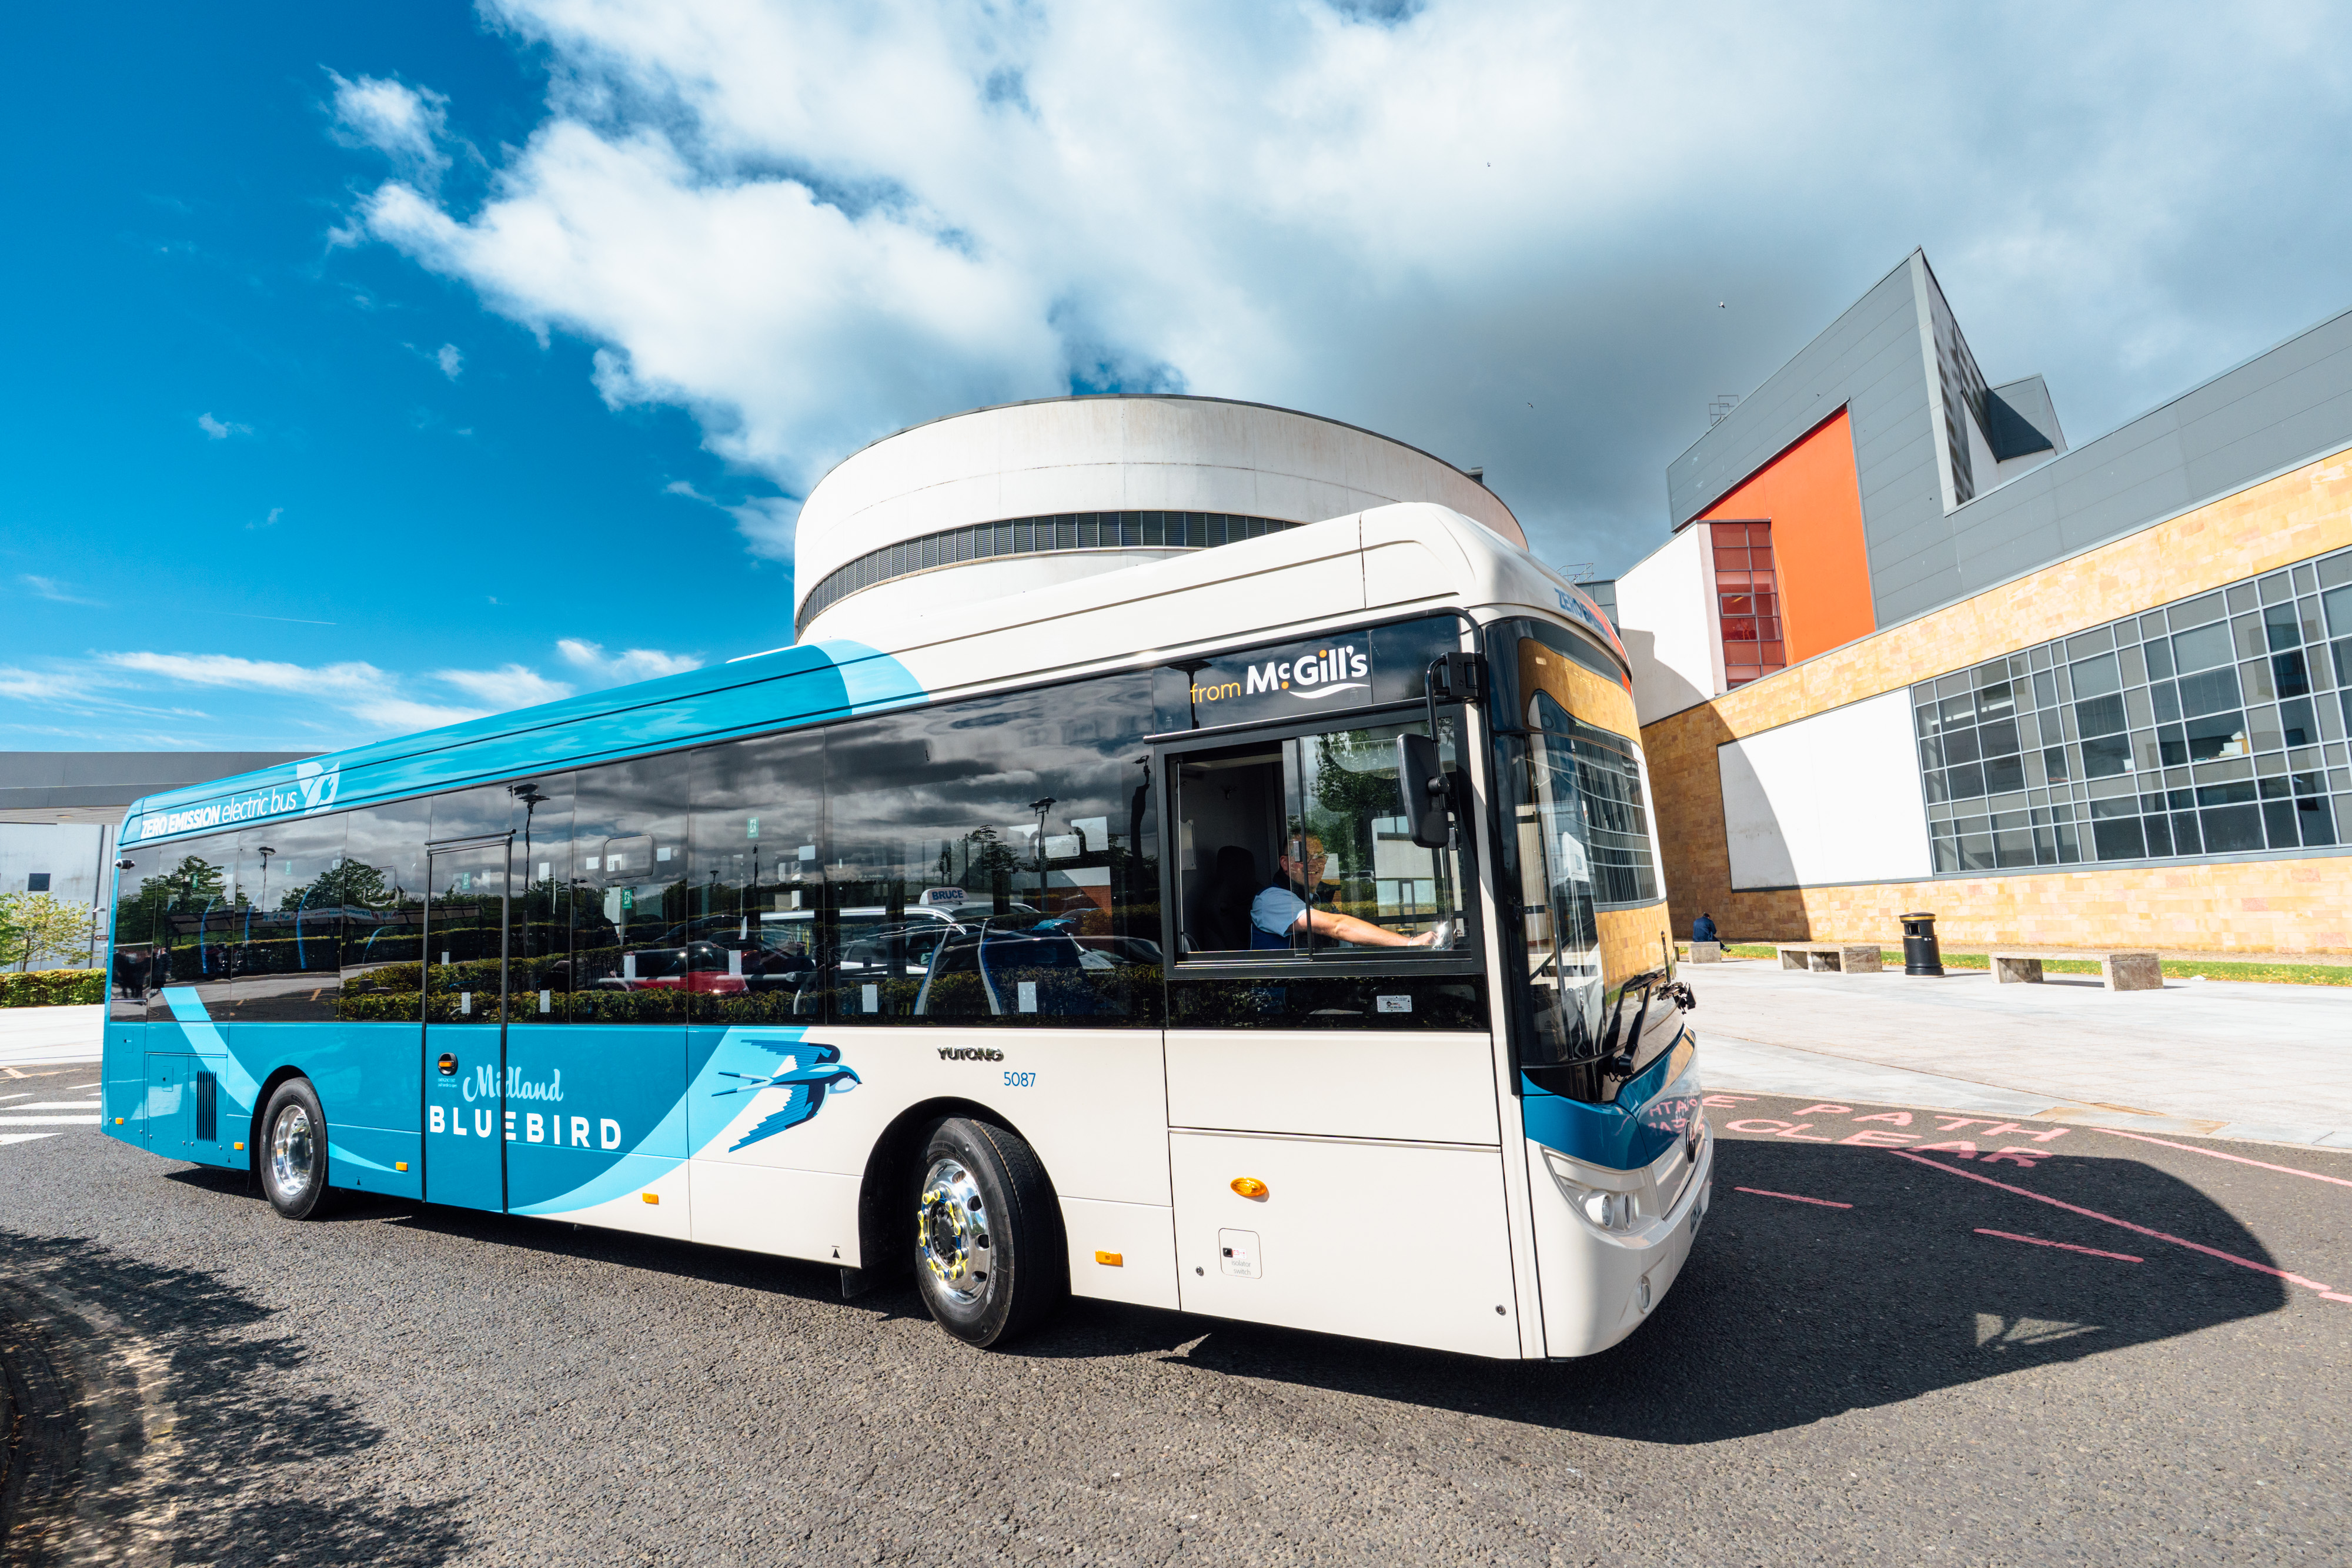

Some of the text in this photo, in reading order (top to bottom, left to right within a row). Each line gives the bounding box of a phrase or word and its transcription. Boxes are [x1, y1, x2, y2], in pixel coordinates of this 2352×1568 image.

[1554, 588, 1583, 618] ZERO
[1190, 646, 1368, 703] from McGill's
[140, 788, 298, 840] ZERO EMISSION electric bus
[932, 890, 964, 901] BRUCE
[937, 1045, 1004, 1062] YUTONG
[463, 1064, 563, 1102] Midland
[1004, 1072, 1036, 1087] 5087
[429, 1105, 621, 1150] BLUEBIRD
[1792, 1104, 2072, 1142] PATH
[1725, 1118, 2054, 1168] CLEAR
[1231, 1259, 1251, 1268] isolator
